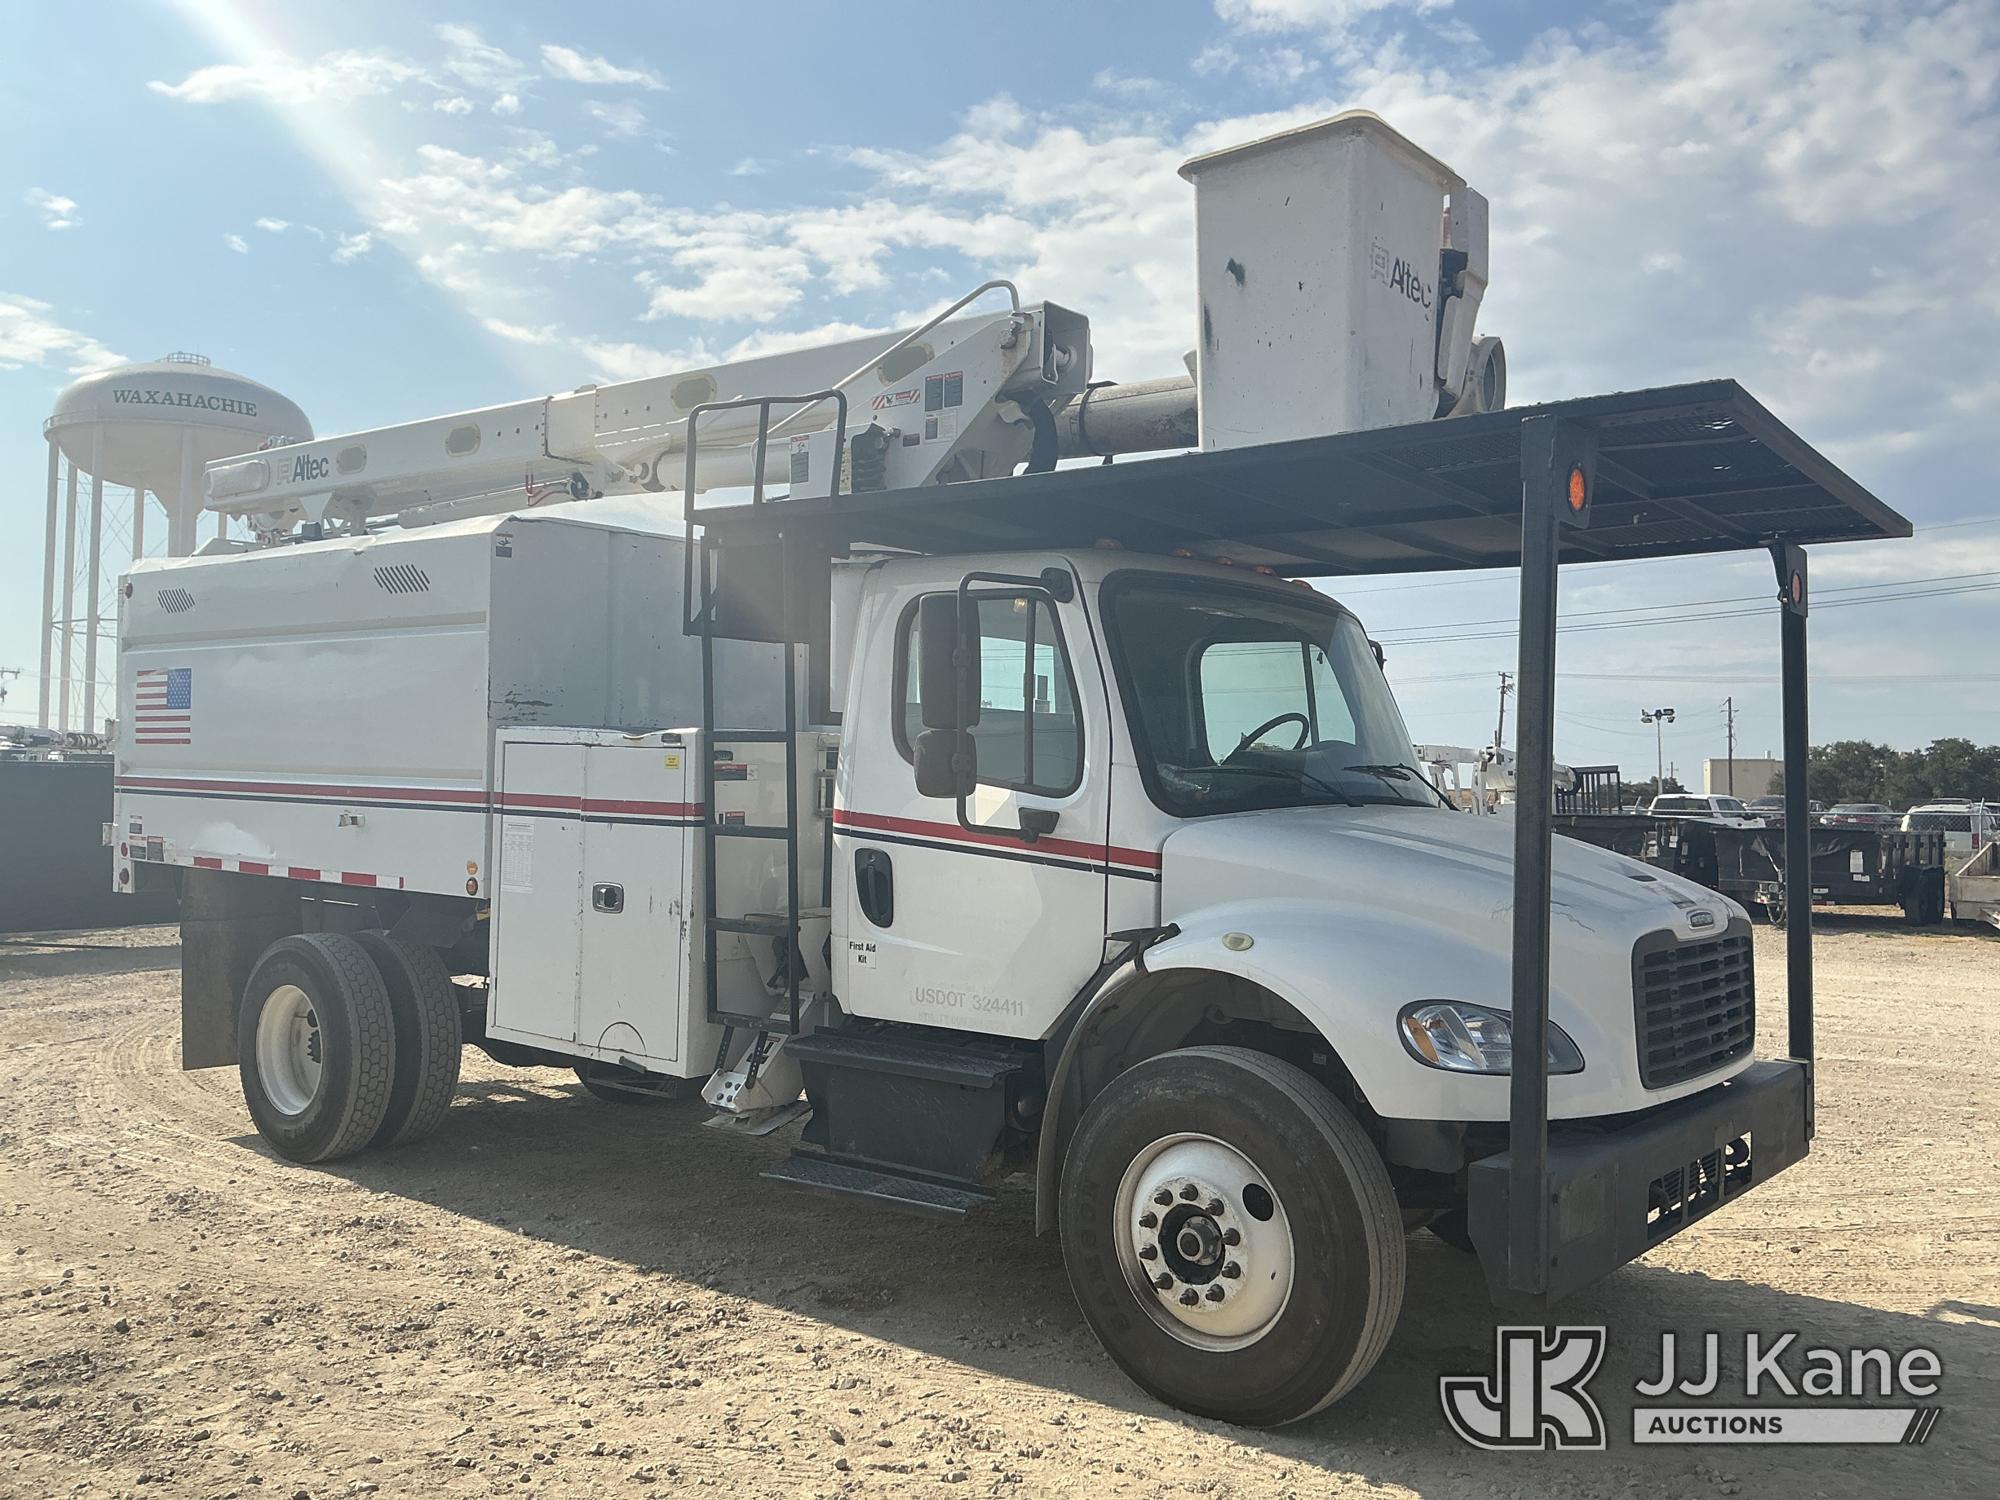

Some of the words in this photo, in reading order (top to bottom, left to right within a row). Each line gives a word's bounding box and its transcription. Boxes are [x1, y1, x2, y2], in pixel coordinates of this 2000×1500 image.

[1389, 256, 1432, 309] Altec
[112, 389, 257, 417] WAXAHACHIE
[292, 453, 329, 483] Altec
[849, 941, 864, 951] First
[865, 943, 876, 953] Aid
[858, 954, 867, 964] Kit
[915, 986, 966, 1009] USDOT
[972, 994, 1024, 1017] 324411
